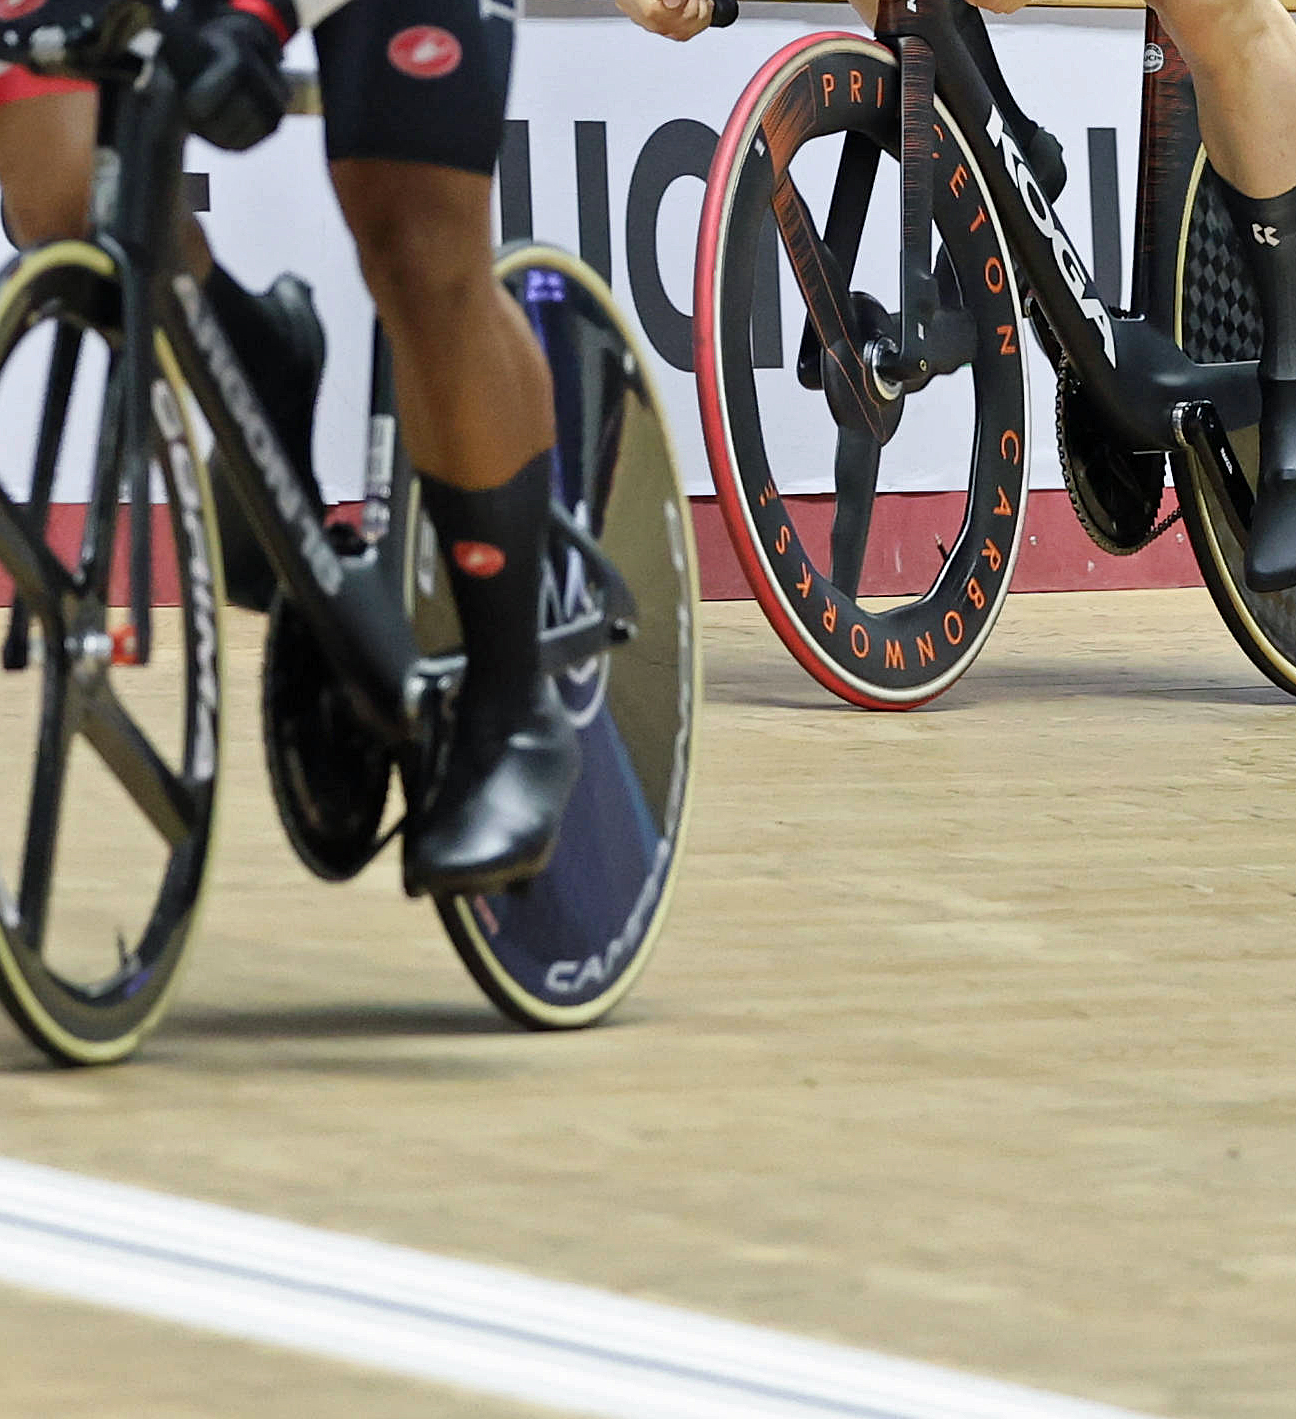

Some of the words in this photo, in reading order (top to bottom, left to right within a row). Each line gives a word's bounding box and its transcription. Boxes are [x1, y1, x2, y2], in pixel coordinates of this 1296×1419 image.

[821, 69, 1018, 357] PRIETON
[986, 103, 1117, 370] KOGA
[774, 429, 1021, 671] CARBONWORKS
